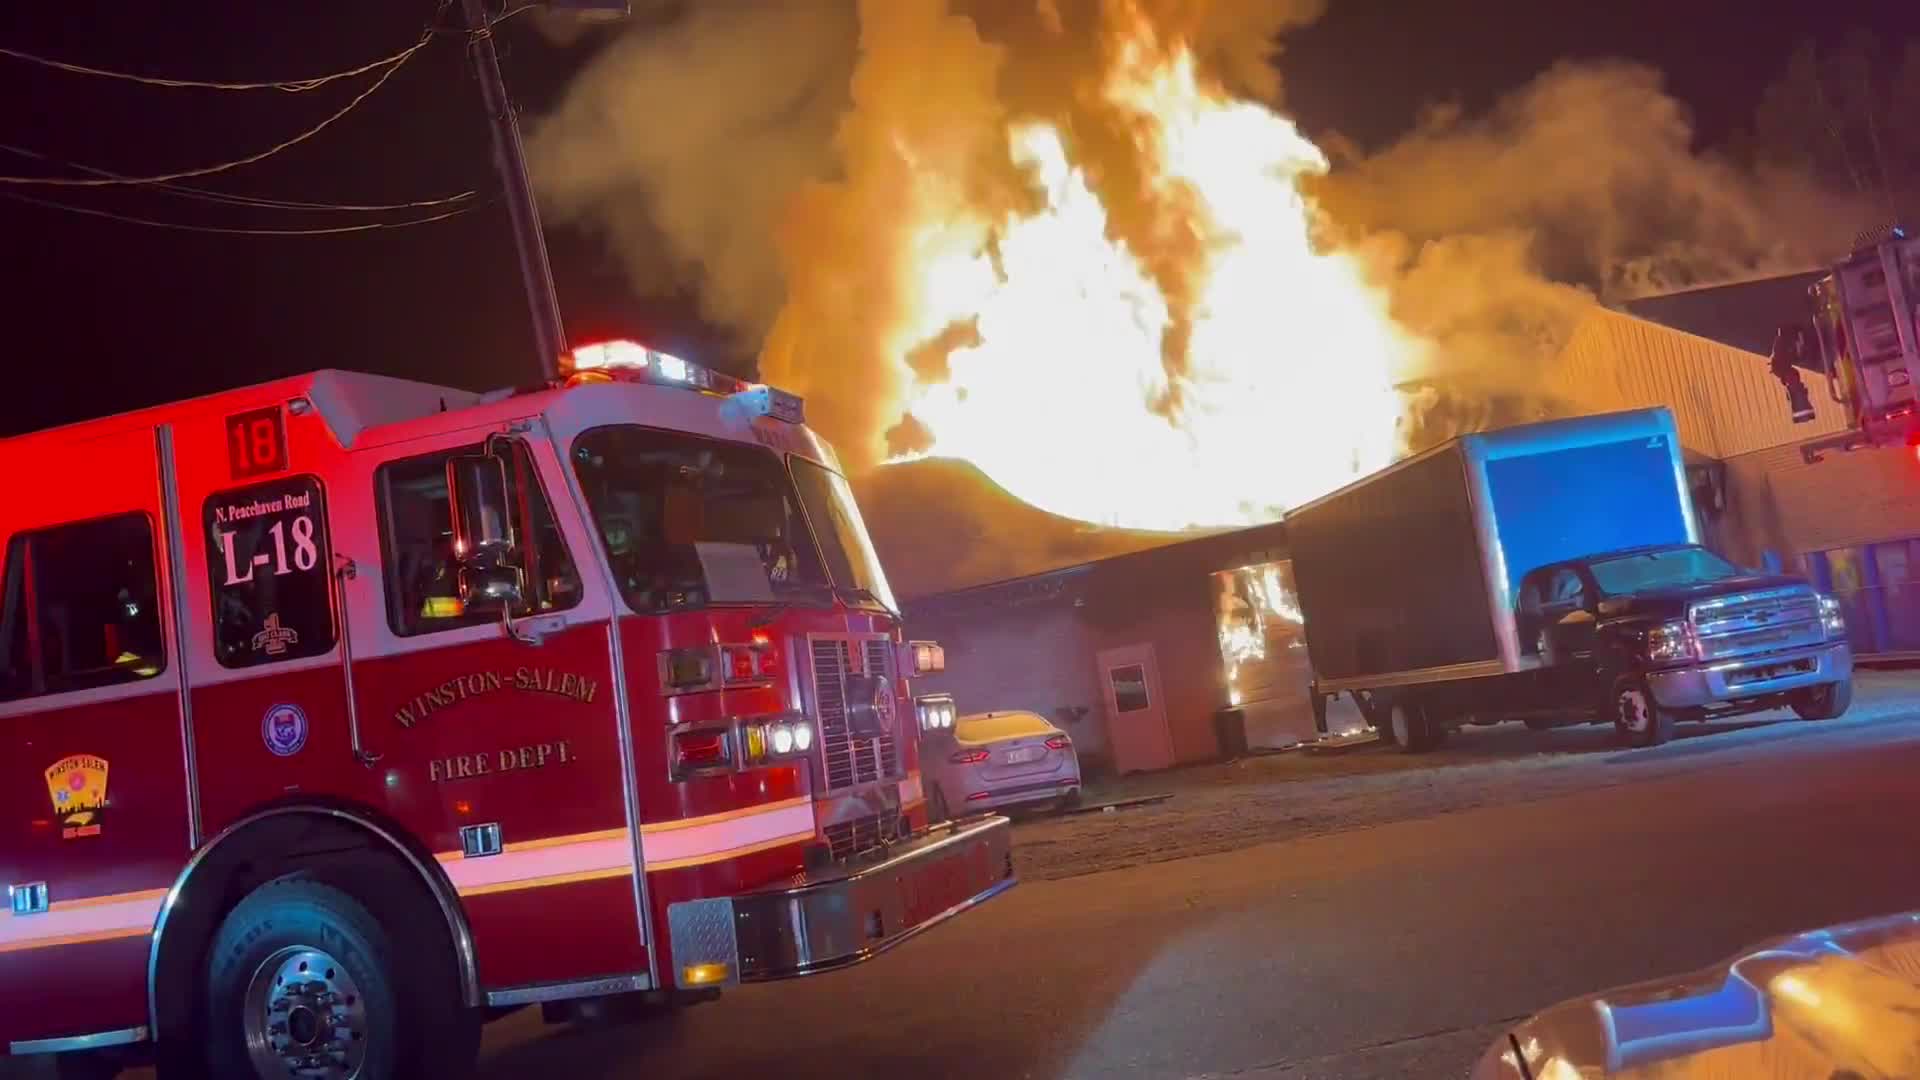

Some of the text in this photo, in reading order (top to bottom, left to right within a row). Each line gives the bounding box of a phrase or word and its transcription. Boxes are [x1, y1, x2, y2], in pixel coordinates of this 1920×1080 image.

[233, 419, 277, 469] 18
[215, 490, 310, 524] N. Peacehaven Road
[219, 516, 318, 586] L-18
[394, 666, 597, 729] WINSTON-SALEM
[429, 740, 577, 783] FIRE DEPT.
